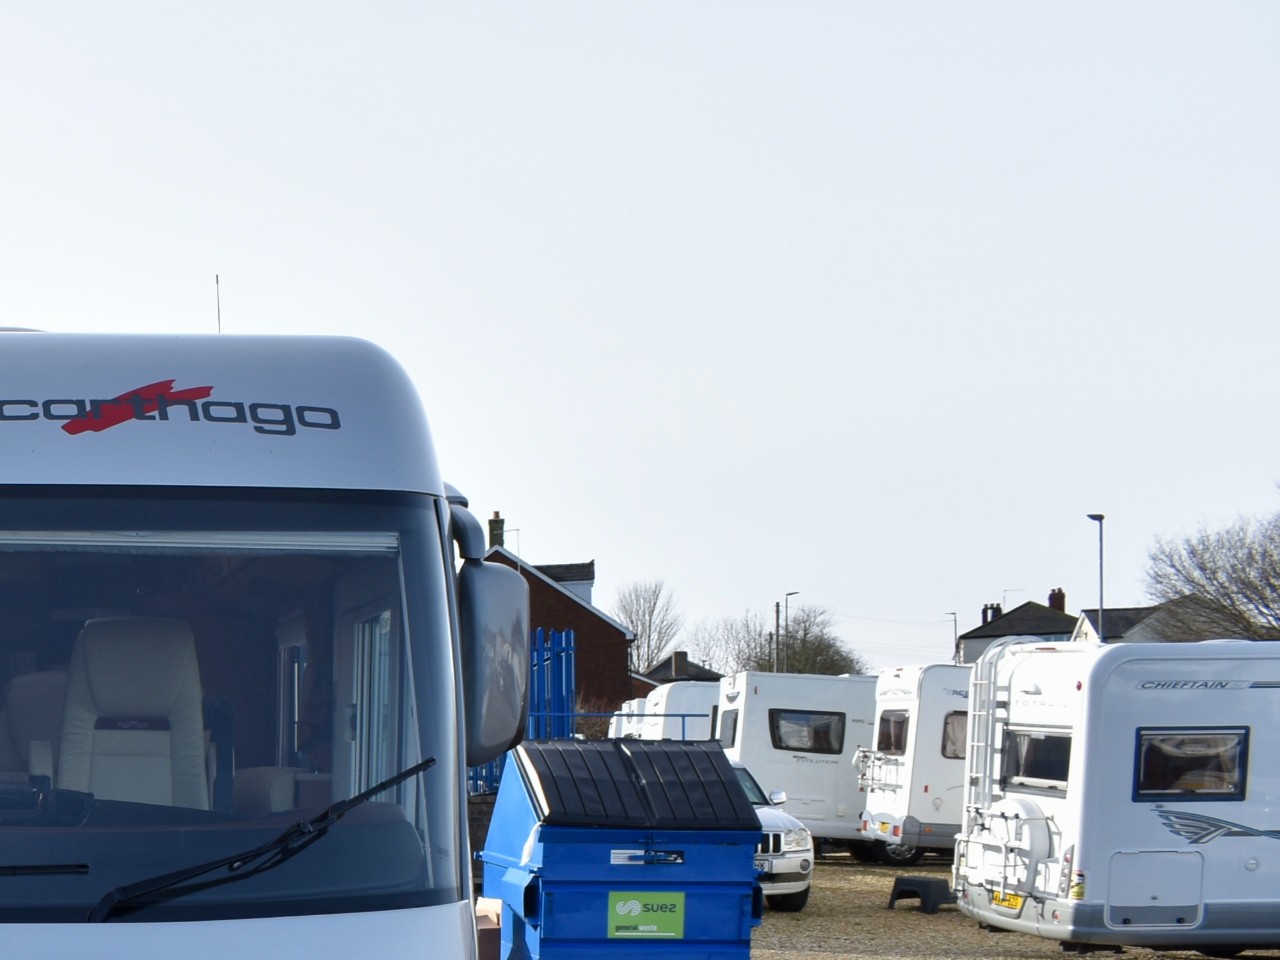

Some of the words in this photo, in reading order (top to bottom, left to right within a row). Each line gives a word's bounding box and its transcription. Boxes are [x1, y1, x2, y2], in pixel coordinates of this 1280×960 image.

[1140, 681, 1229, 689] CHIEFTAIN
[642, 903, 677, 913] suez
[615, 924, 638, 932] general
